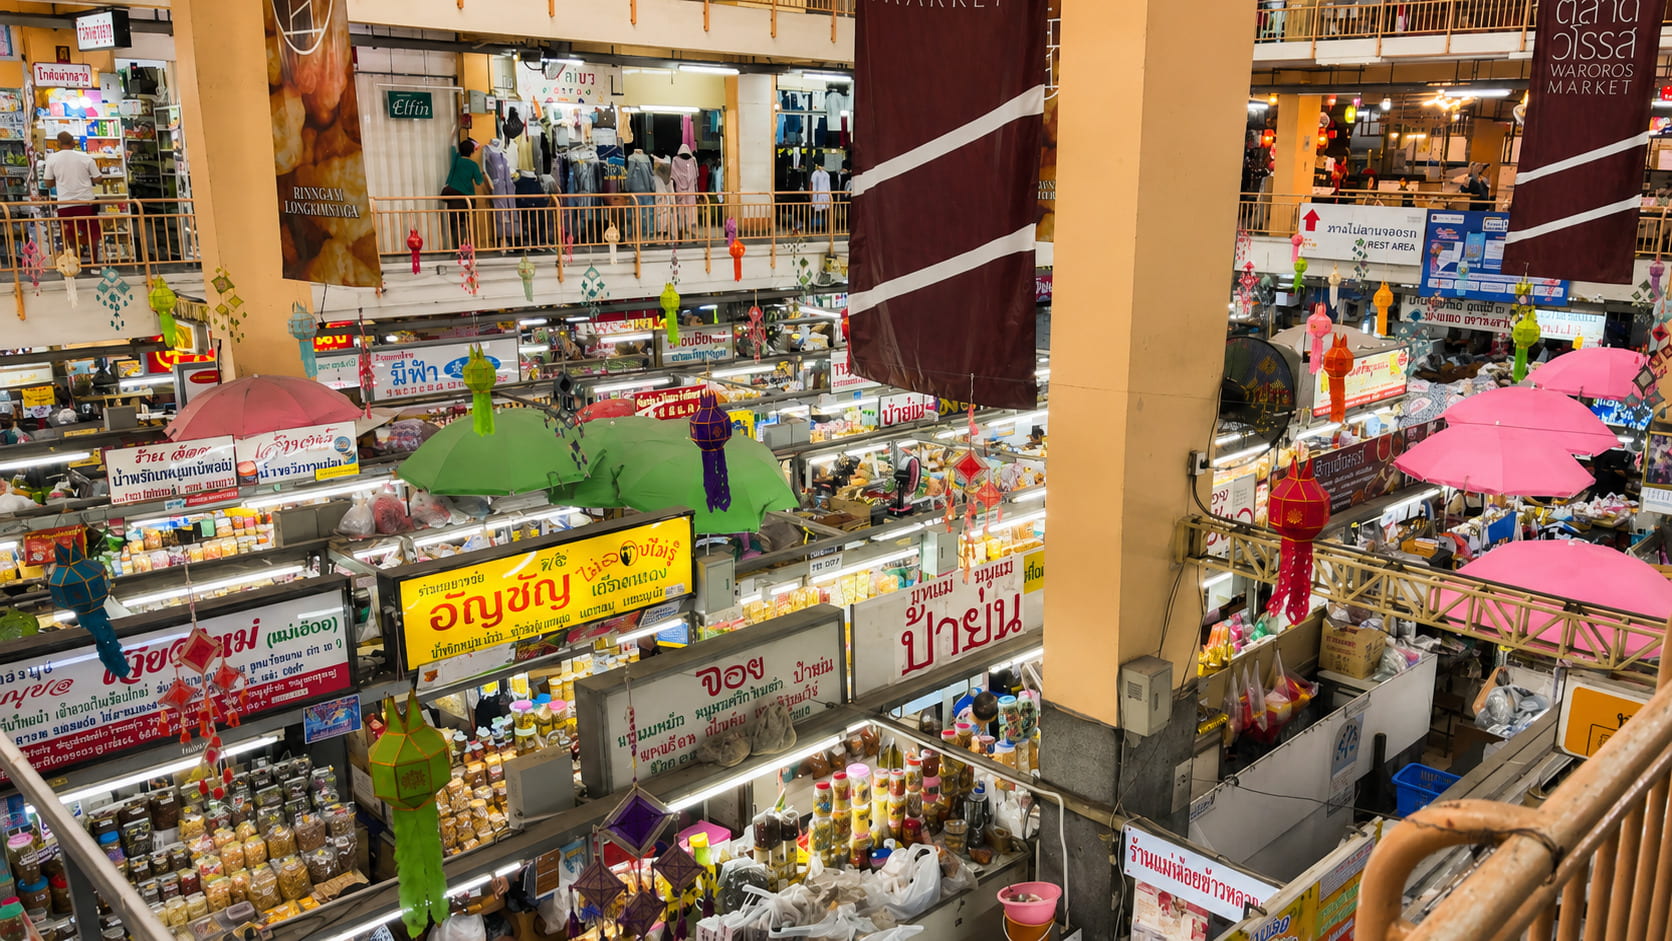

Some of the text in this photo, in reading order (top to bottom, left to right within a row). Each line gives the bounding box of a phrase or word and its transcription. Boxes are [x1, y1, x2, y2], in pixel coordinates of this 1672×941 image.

[1550, 64, 1634, 78] WAROROS
[1547, 80, 1632, 95] MARKET
[1391, 243, 1416, 252] AREA
[429, 572, 570, 632] อัญชัญ
